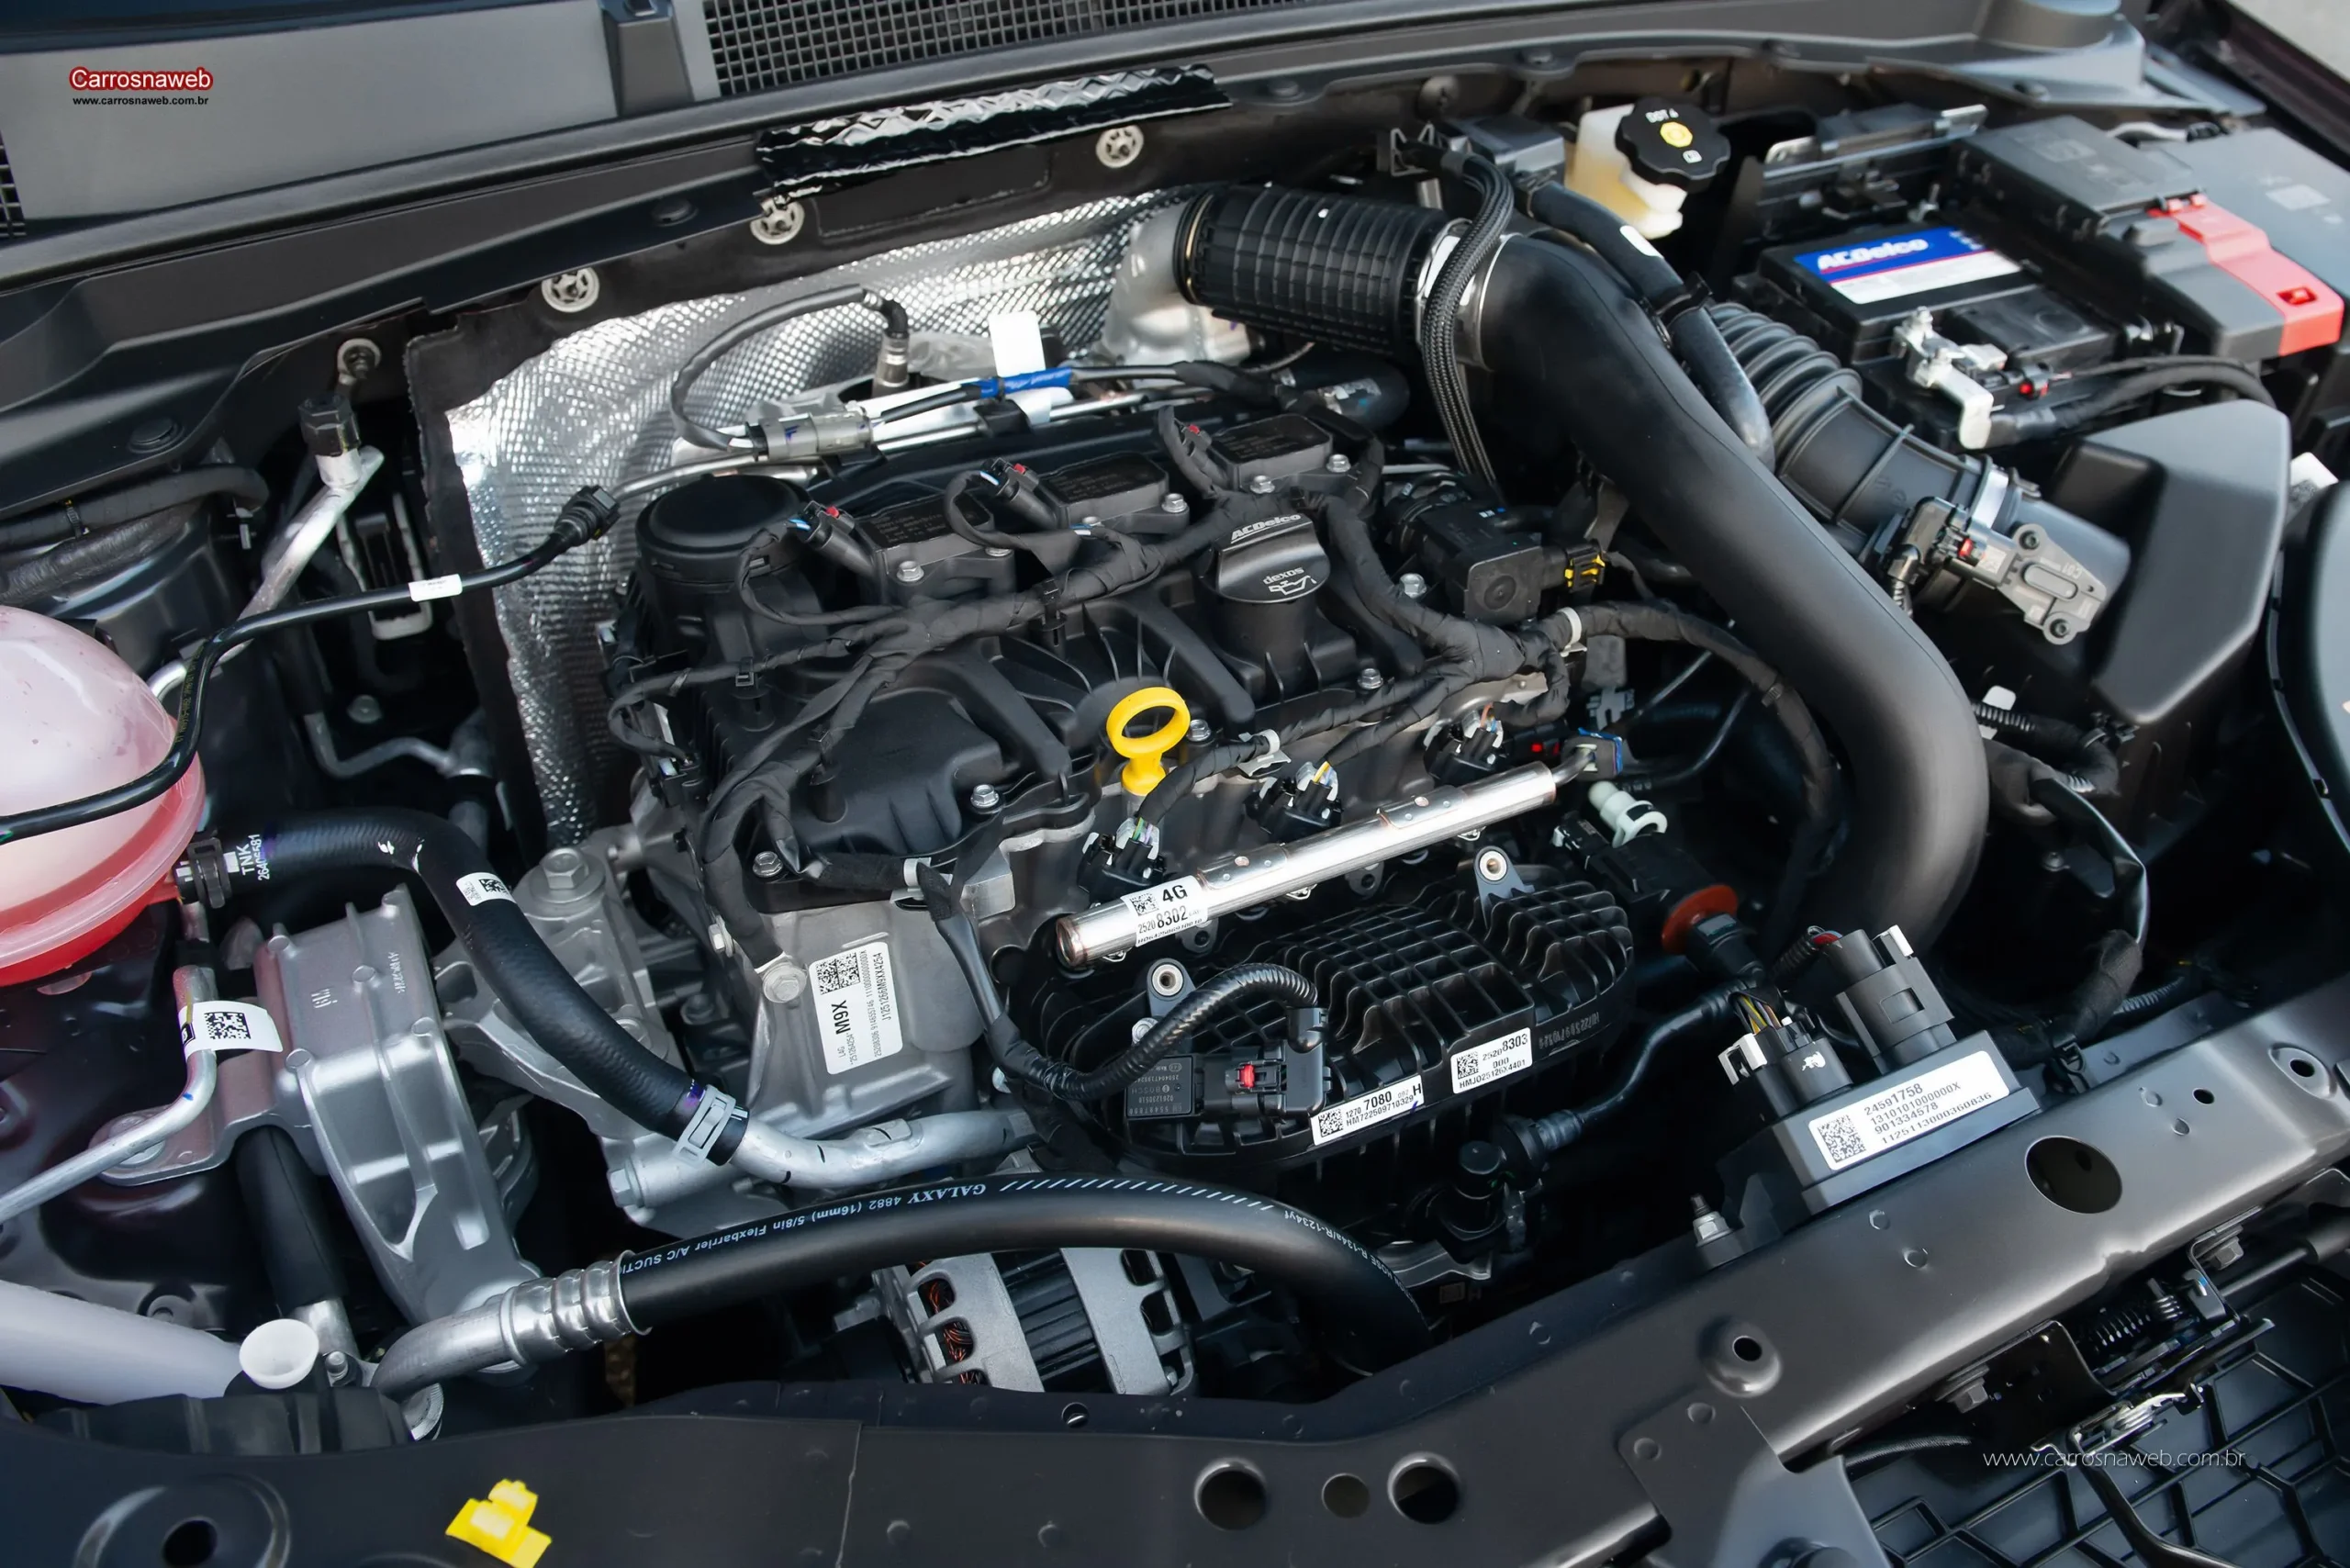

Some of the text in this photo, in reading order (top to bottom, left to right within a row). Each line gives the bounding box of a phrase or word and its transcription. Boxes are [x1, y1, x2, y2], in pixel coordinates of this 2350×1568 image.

[1817, 238, 1930, 271] ACDelco
[1231, 514, 1302, 541] ACDelco
[1262, 566, 1304, 585] dexos
[235, 843, 255, 876] TNK
[1162, 884, 1188, 902] 4G
[831, 1000, 852, 1035] M9X
[1413, 1083, 1422, 1096] H
[1863, 1083, 1923, 1116] 24591758
[1874, 1103, 1939, 1135] 901334578
[868, 1194, 901, 1211] 4882
[907, 1183, 986, 1204] GALAXY
[772, 1215, 805, 1230] 5/8in
[811, 1201, 862, 1223] (16mm)
[695, 1225, 767, 1252] Flexbarrier
[1284, 1210, 1368, 1260] R-134a/R-1234yf
[666, 1245, 690, 1260] A/C
[1370, 1254, 1393, 1280] HOSE
